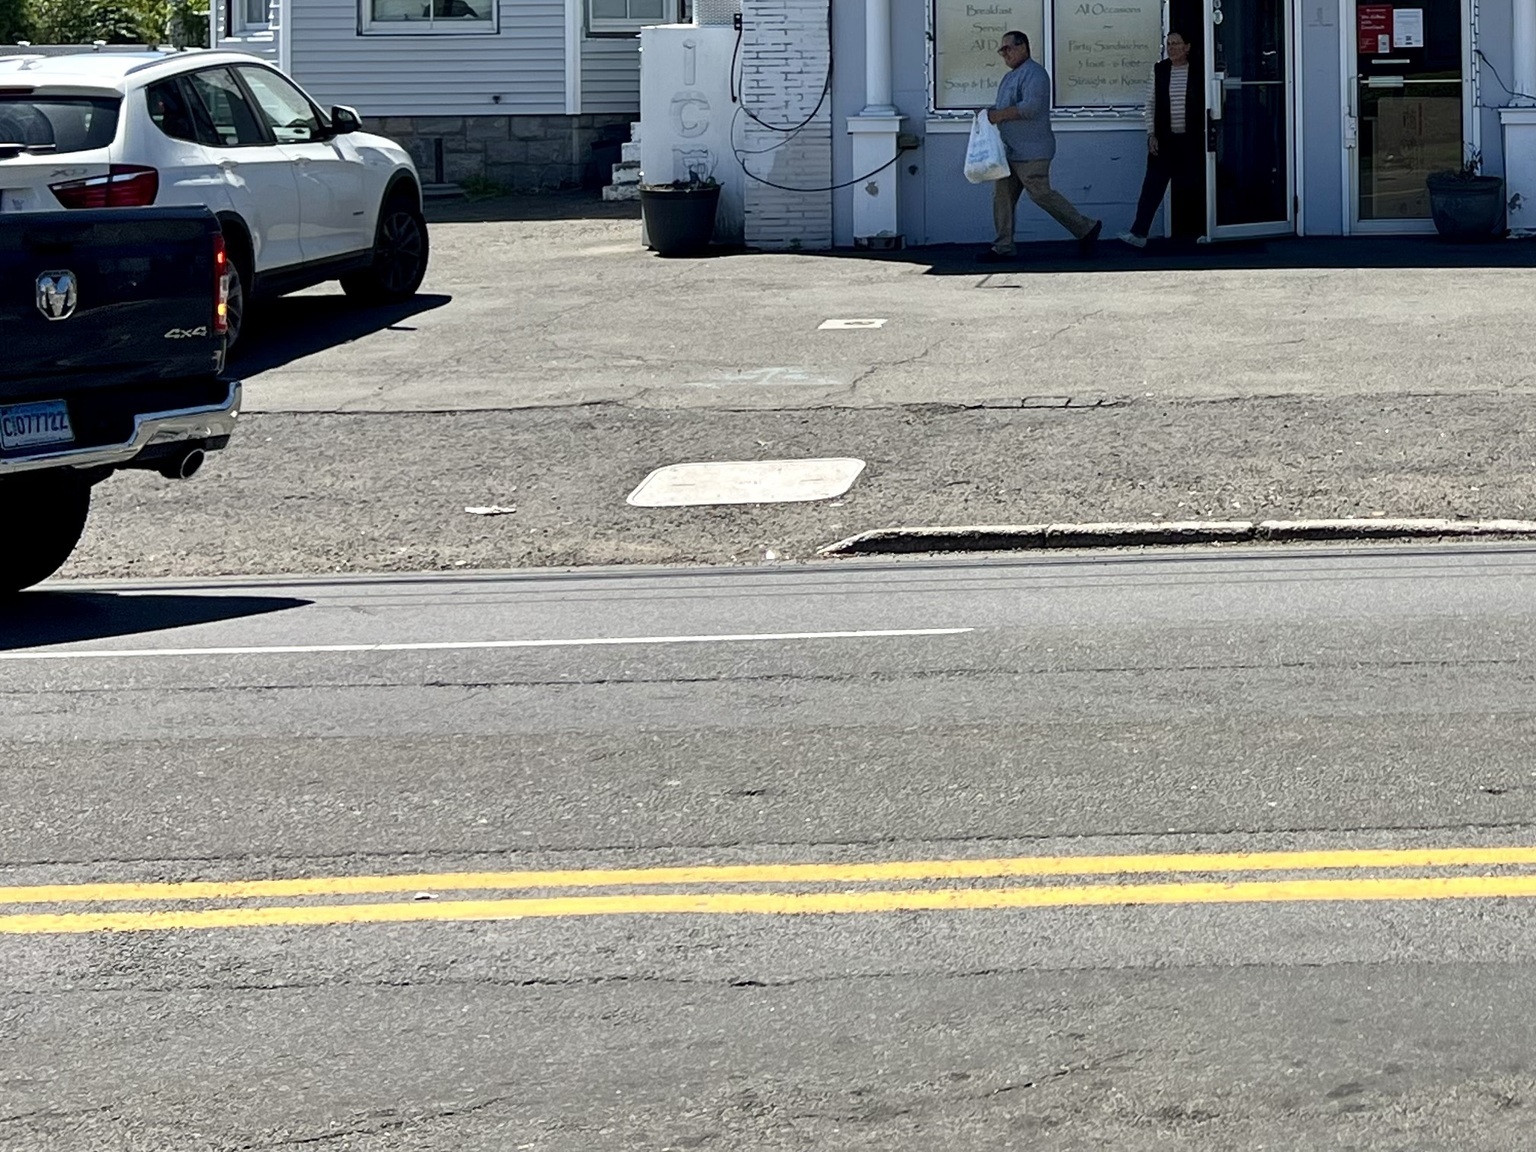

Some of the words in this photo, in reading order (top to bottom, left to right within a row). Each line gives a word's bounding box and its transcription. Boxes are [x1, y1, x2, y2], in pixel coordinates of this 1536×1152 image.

[966, 4, 1013, 17] Breakfast
[1074, 3, 1090, 16] All
[1091, 2, 1142, 16] Occasions
